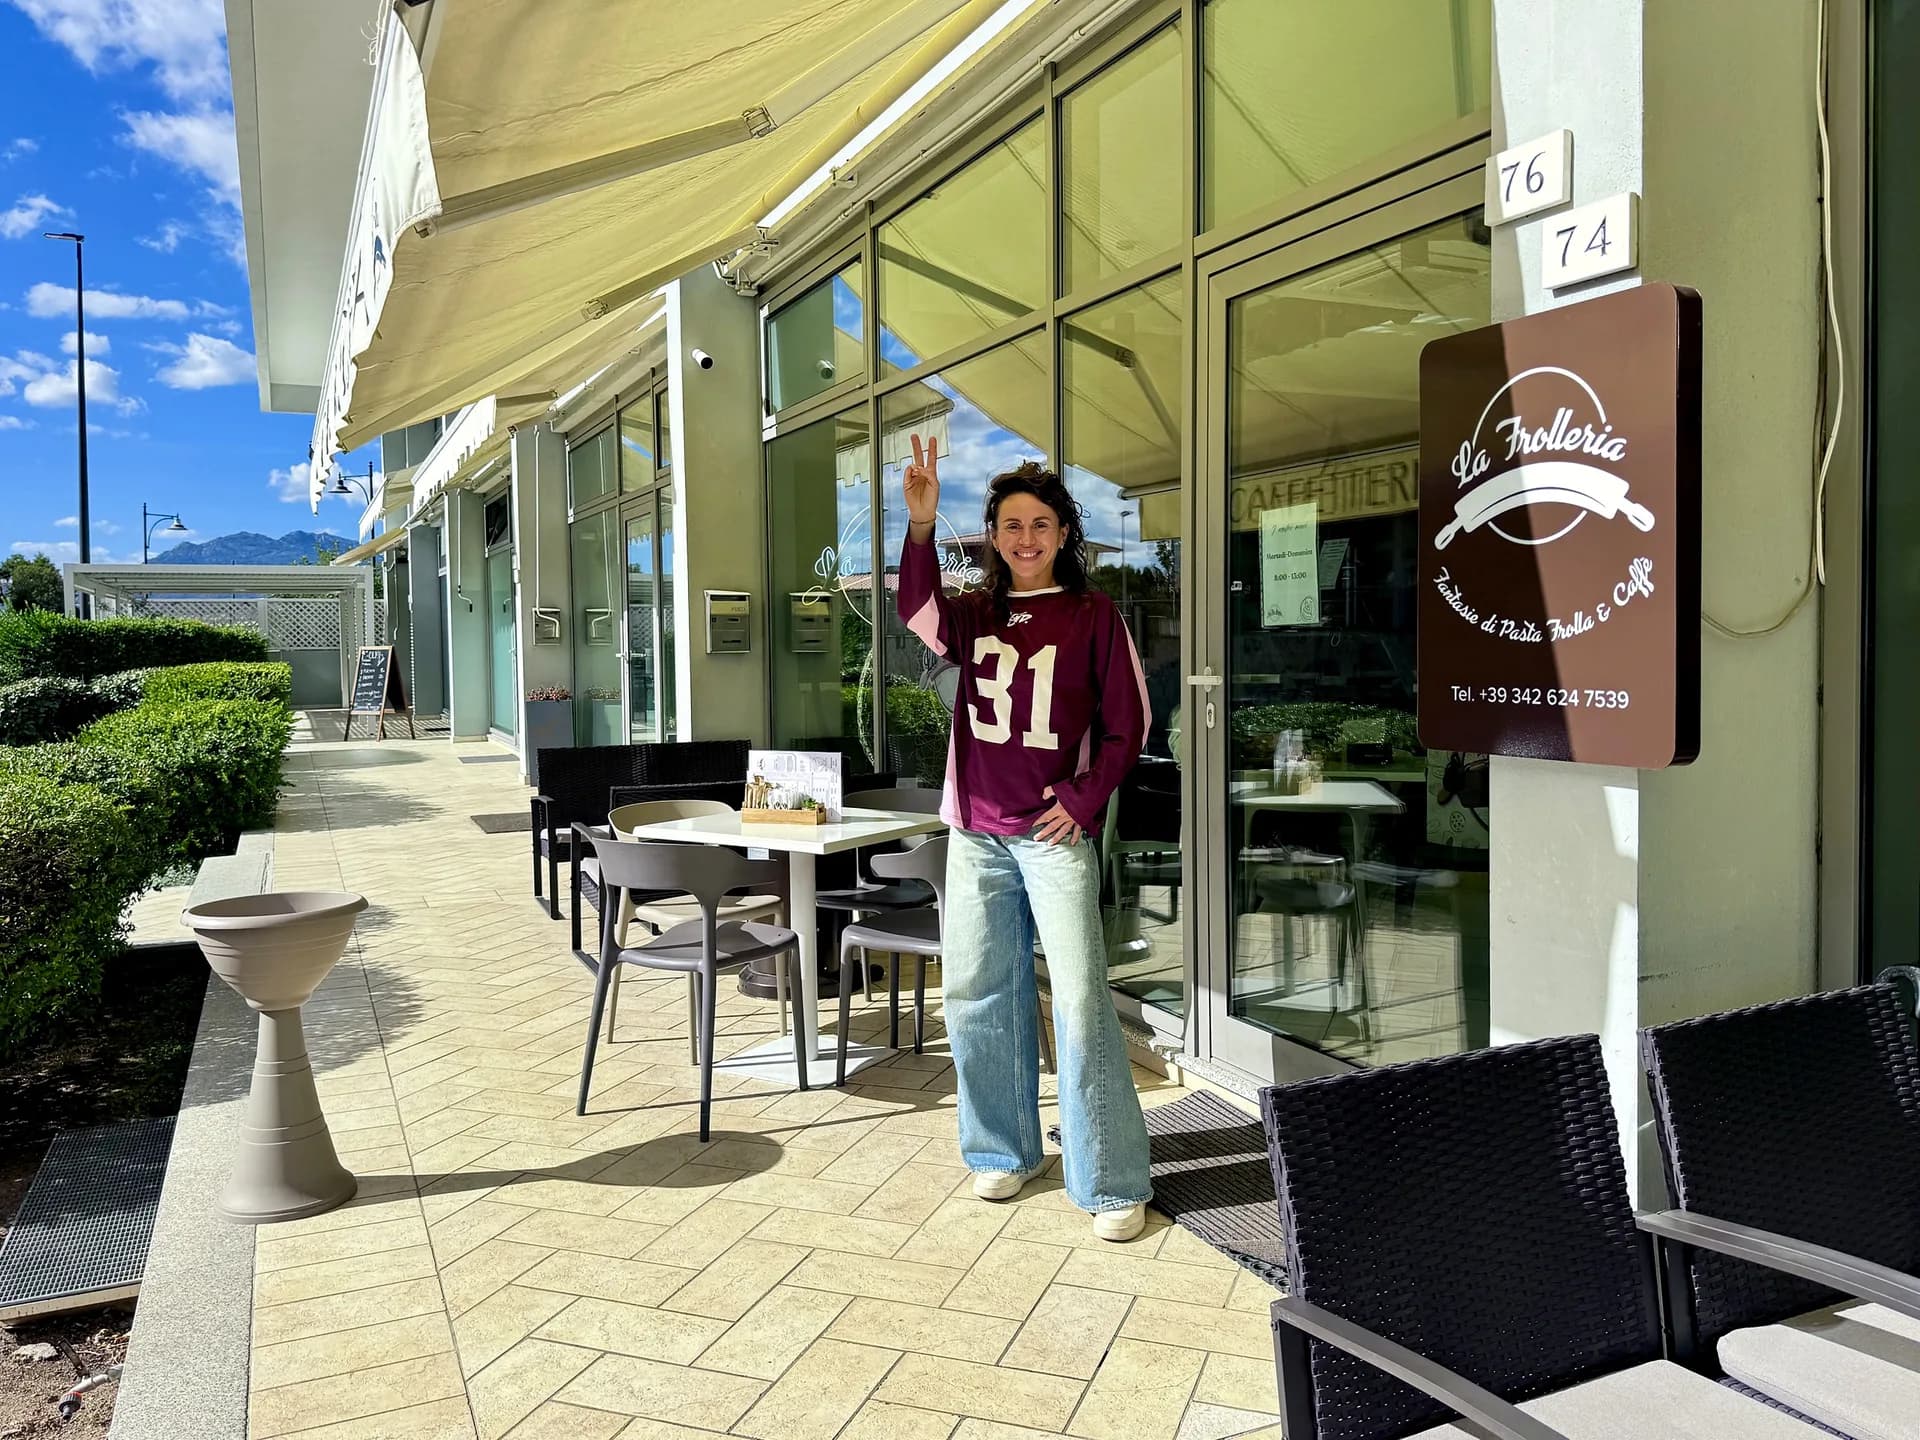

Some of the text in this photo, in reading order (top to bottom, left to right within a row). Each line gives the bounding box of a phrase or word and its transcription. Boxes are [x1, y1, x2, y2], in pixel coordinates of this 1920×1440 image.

[1501, 151, 1546, 202] 76
[1556, 216, 1612, 267] 74
[1451, 407, 1627, 489] La Frolleria
[1433, 557, 1654, 642] Fantasie di Pasta Frolla & Caffè
[967, 635, 1059, 750] 31
[1451, 686, 1629, 709] Tel. +39 342 624 7539
